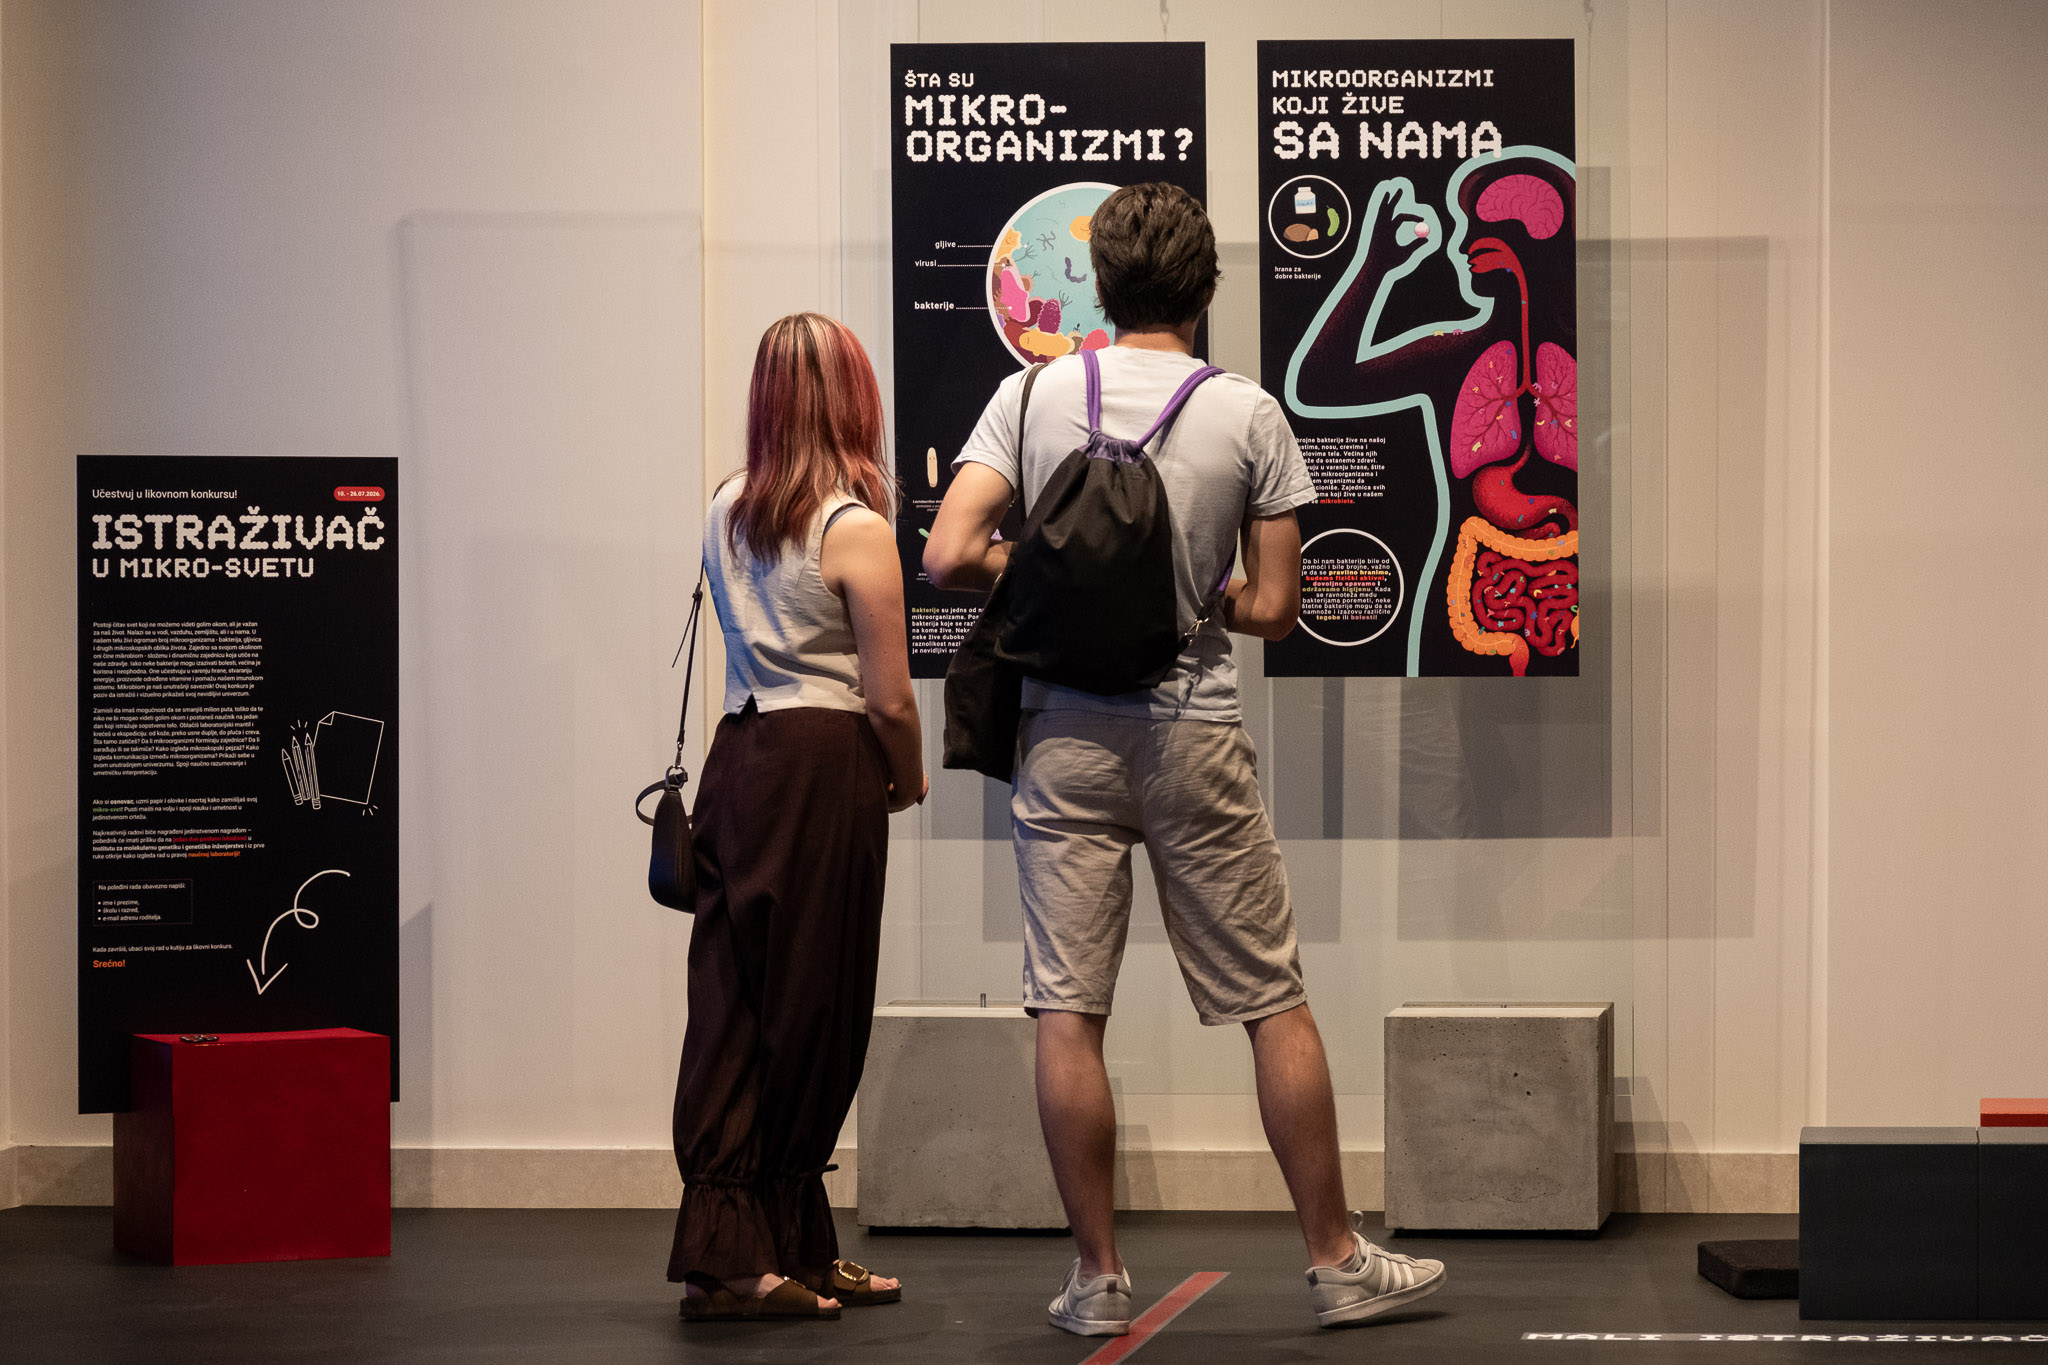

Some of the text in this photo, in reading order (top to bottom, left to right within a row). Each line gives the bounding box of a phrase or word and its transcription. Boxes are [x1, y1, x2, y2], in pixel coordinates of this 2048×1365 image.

[905, 70, 973, 88] ŠTA SU
[1272, 70, 1494, 88] MIKROORGANIZMI
[905, 94, 1067, 126] MIKRO-
[1273, 92, 1404, 114] KOJI ŽIVE
[1273, 120, 1502, 160] SA NAMA
[934, 241, 956, 249] gljive
[914, 302, 954, 311] bakterije
[92, 489, 134, 500] Učestvuj
[145, 489, 188, 499] likovnom
[191, 490, 237, 499] konkursu!
[92, 507, 385, 550] ISTRAŽIVAČ
[92, 558, 314, 578] U MIKRO-SVETU
[92, 959, 126, 968] Srećno!
[1527, 1333, 1663, 1341] MALI
